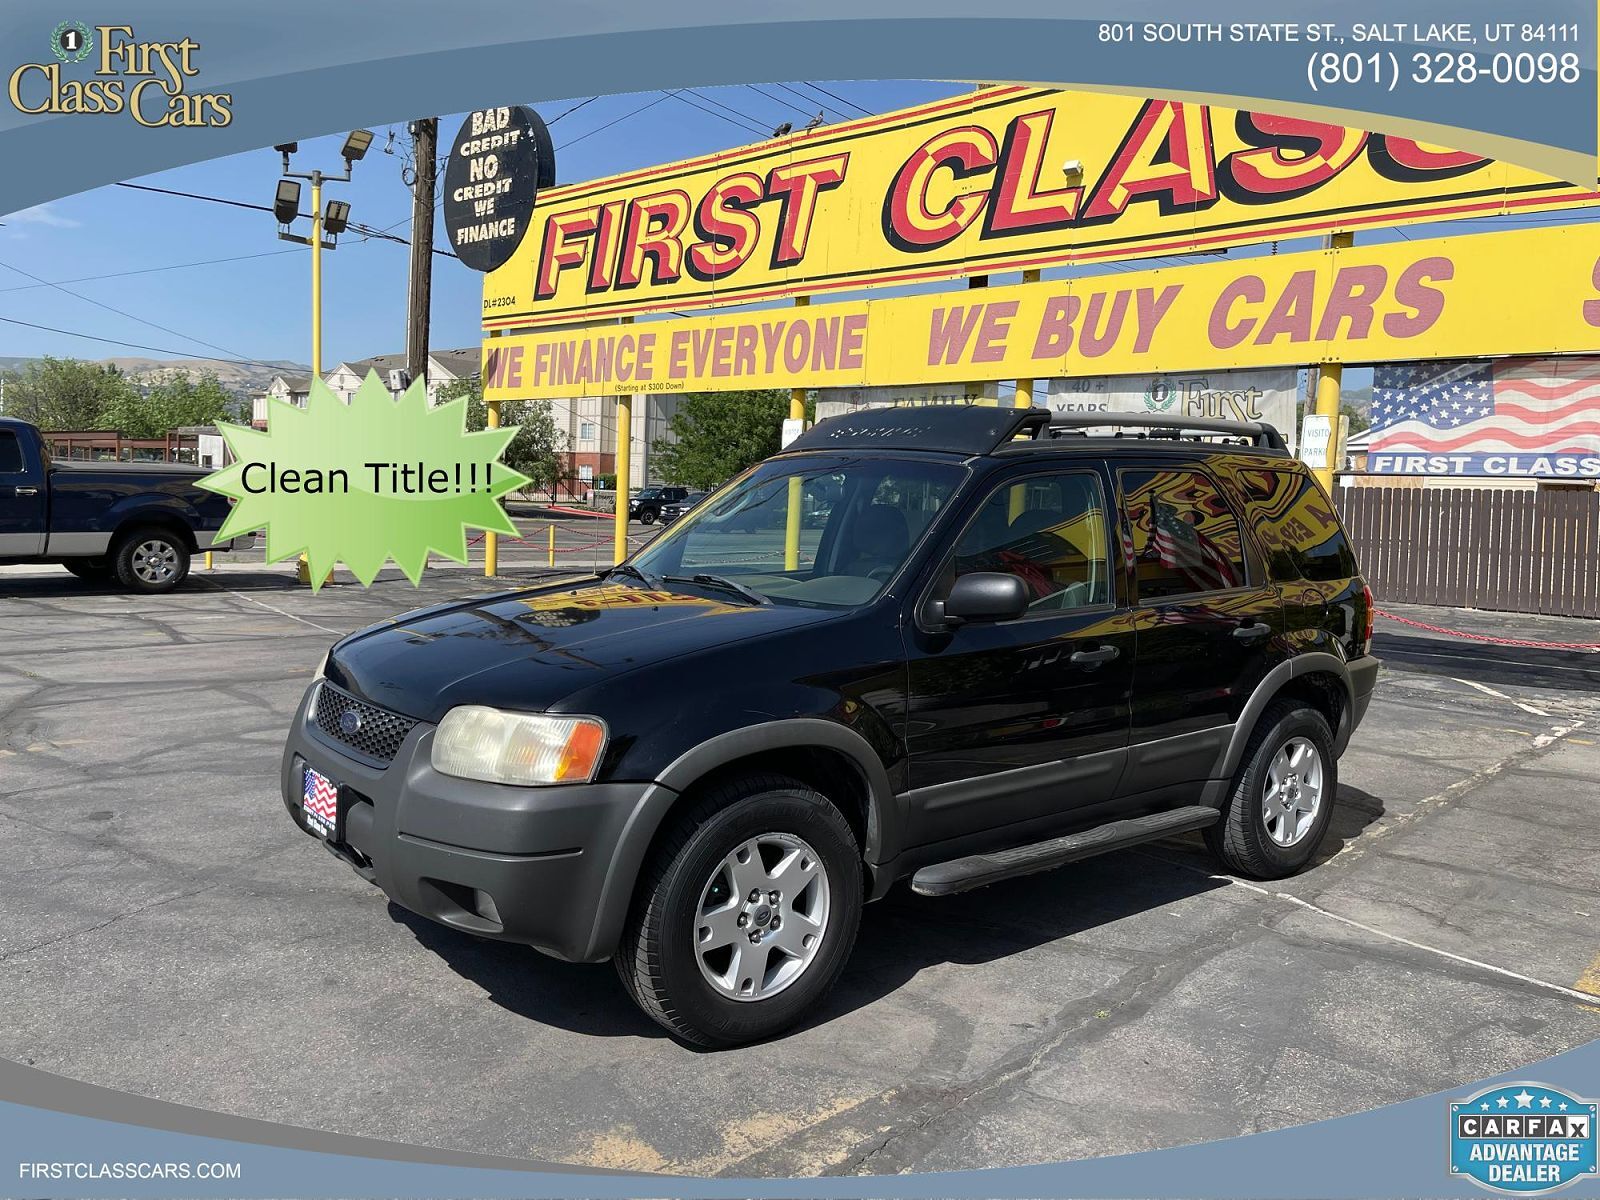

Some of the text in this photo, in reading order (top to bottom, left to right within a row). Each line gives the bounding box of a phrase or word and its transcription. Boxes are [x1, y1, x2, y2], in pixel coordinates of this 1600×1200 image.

[471, 106, 511, 137] BAD
[460, 130, 522, 157] CREDIT
[470, 154, 499, 182] NO
[453, 178, 513, 202] CREDIT
[474, 198, 495, 217] WE
[457, 217, 516, 245] FINANCE
[533, 152, 850, 301] FIRST
[483, 296, 516, 309] DL#2304
[927, 256, 1455, 366] WE BUY CARS
[485, 314, 868, 390] WE FINANCE EVERYONE
[1072, 380, 1090, 392] 40
[1178, 378, 1263, 424] First
[1307, 428, 1330, 437] VISITO
[1303, 447, 1326, 456] PARKI
[1374, 456, 1600, 475] FIRST CLASS
